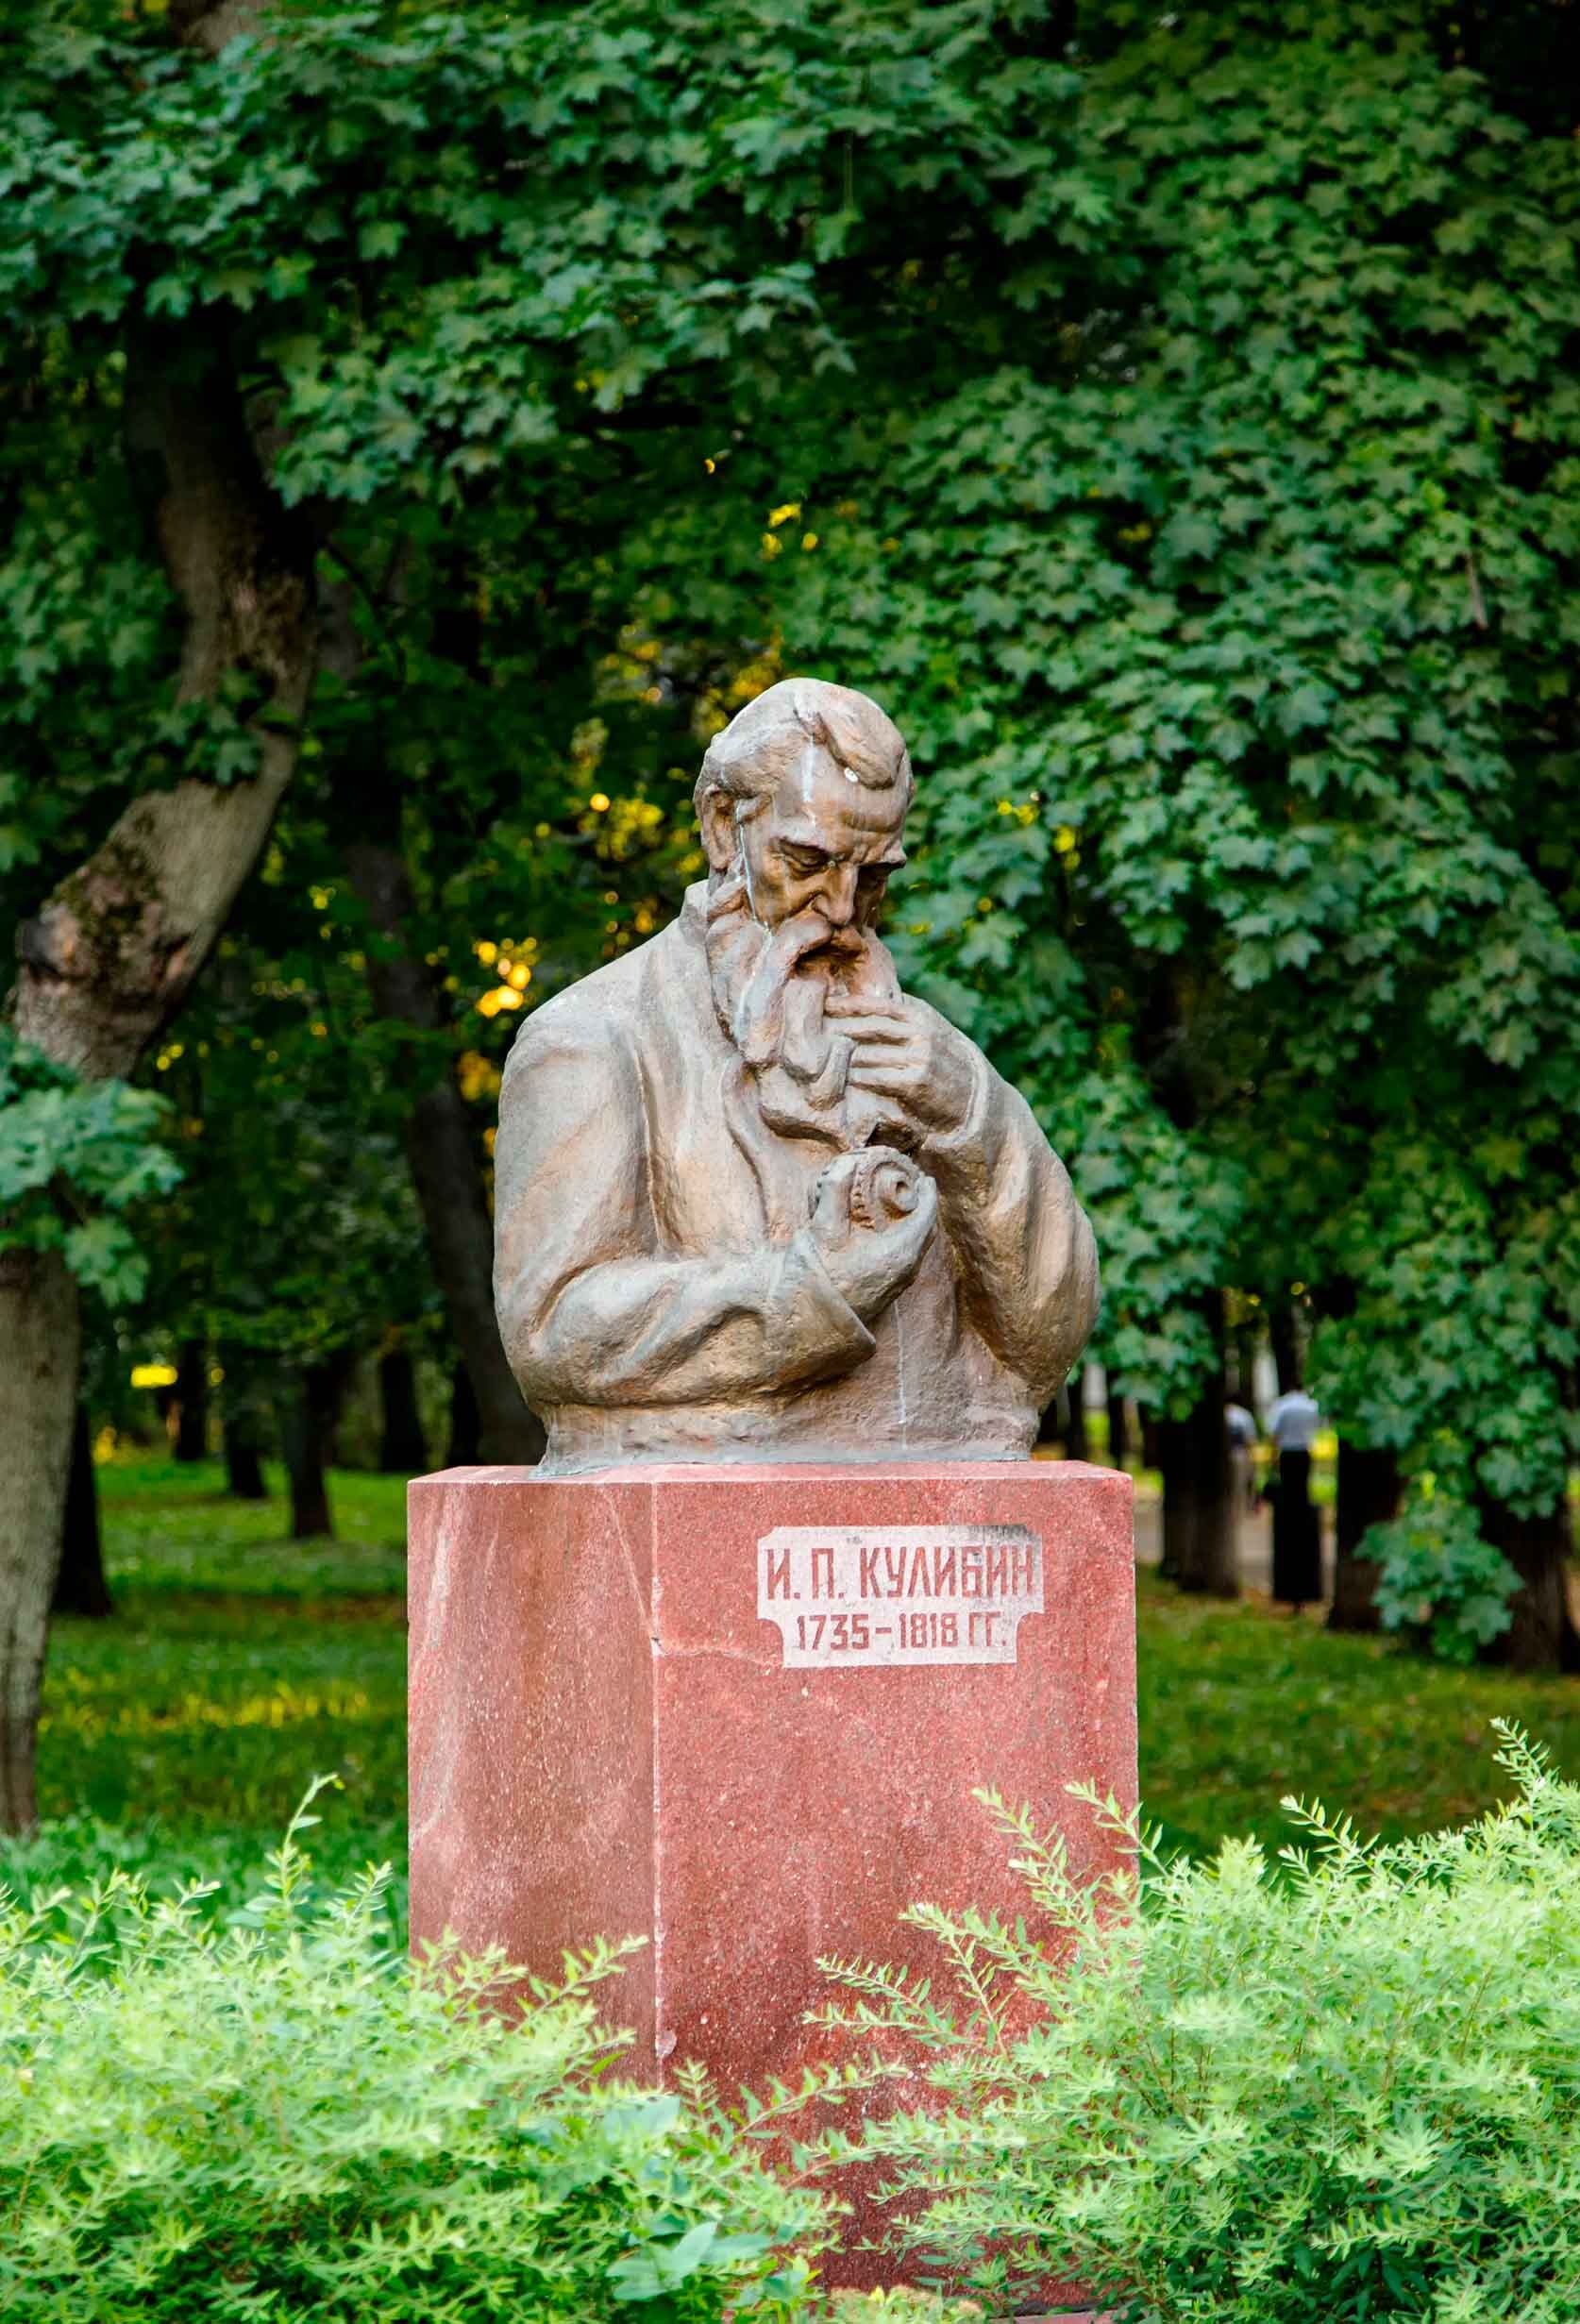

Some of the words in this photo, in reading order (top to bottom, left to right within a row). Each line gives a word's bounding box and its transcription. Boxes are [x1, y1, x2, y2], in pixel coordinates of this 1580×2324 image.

[766, 1548, 800, 1600] И.
[811, 1547, 845, 1599] П.
[859, 1546, 1034, 1598] КУЛИБИН
